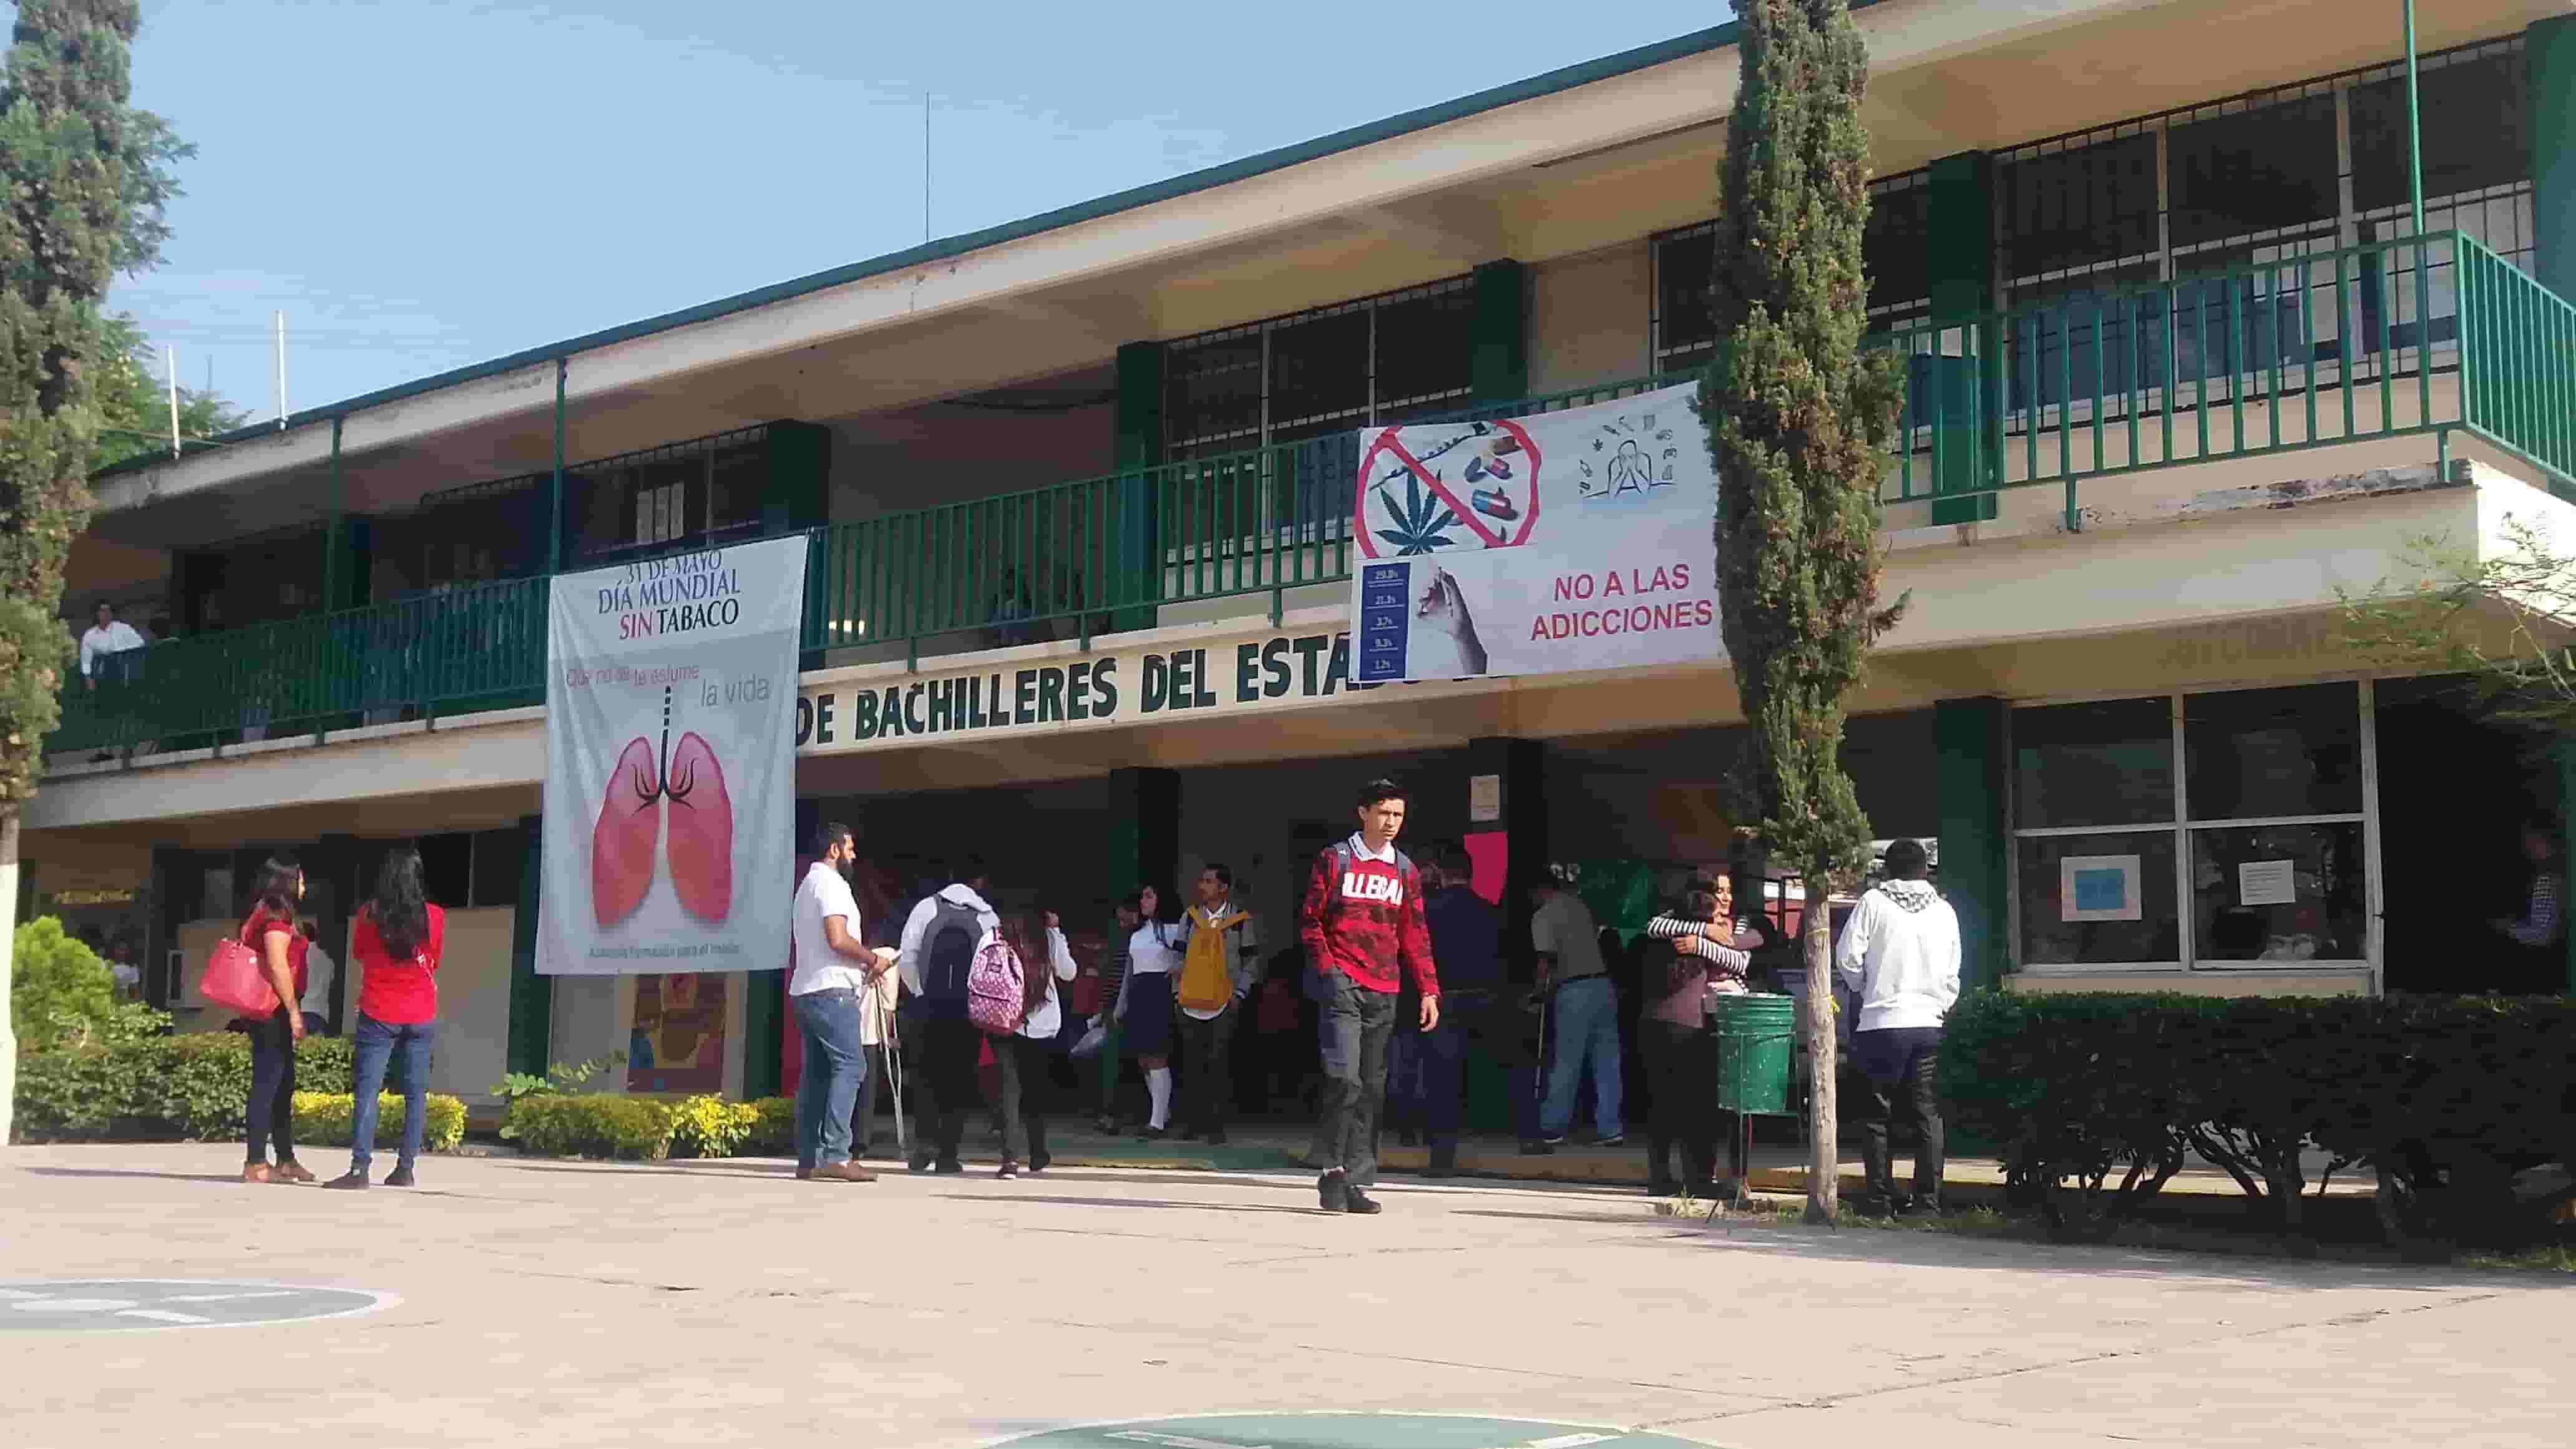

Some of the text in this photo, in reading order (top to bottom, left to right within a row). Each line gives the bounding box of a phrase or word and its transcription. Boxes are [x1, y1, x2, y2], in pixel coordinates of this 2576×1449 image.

[598, 568, 741, 614] DÍA MUNDIAL
[1554, 564, 1689, 601] NO A LAS
[619, 598, 739, 639] SIN TABACO
[1530, 599, 1713, 640] ADICCIONES
[700, 673, 771, 708] la vida
[796, 631, 1387, 746] DE BACHILLERES DEL ESTA
